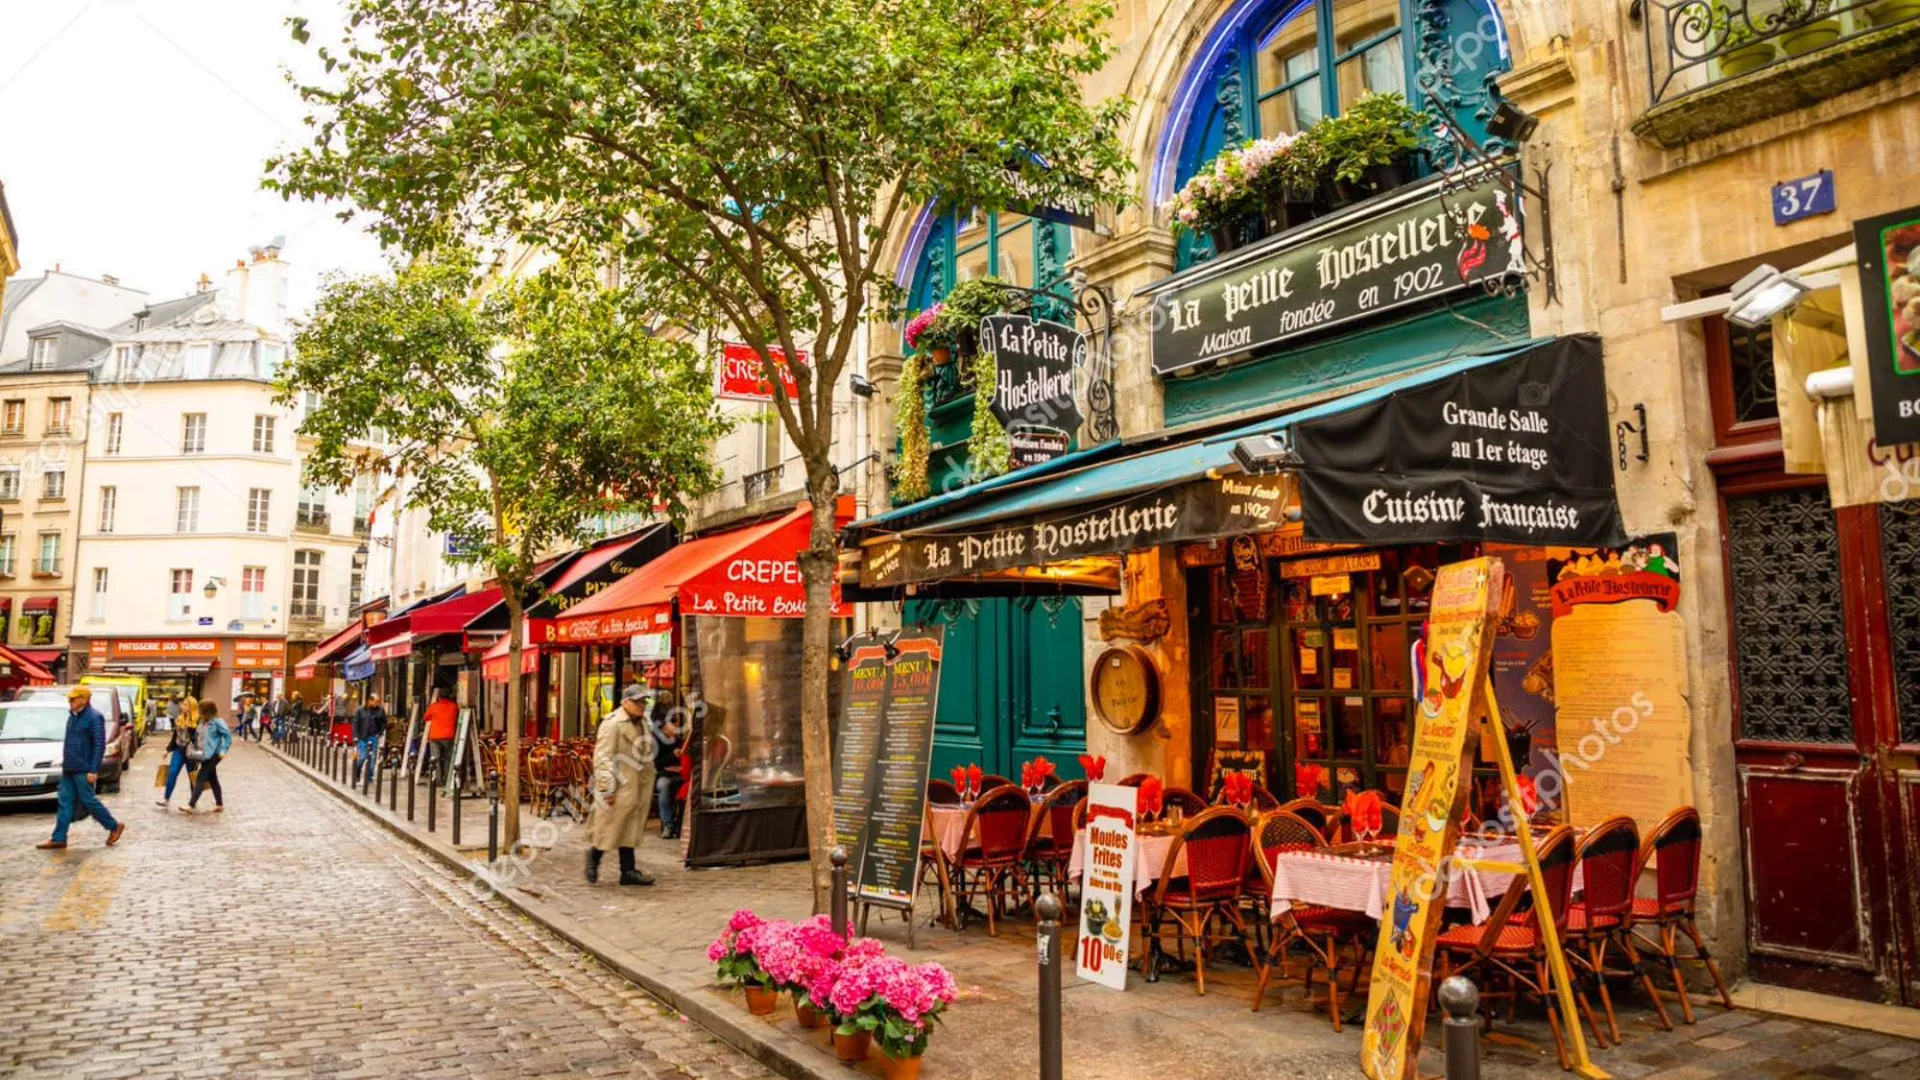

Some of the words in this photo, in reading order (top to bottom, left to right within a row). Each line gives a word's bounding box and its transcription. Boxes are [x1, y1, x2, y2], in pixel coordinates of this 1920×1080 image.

[1780, 178, 1823, 216] 37
[1168, 298, 1201, 334] La
[1199, 325, 1251, 357] Maison
[1279, 298, 1336, 334] fondée
[1358, 285, 1379, 310] en
[1393, 264, 1443, 299] 1902
[999, 323, 1020, 354] La
[1021, 324, 1068, 363] Petite
[999, 365, 1073, 412] Hostellerie
[1443, 401, 1506, 433] Grande
[1510, 410, 1549, 434] Salle
[1451, 439, 1472, 459] au
[1475, 438, 1503, 462] 1er
[1507, 441, 1549, 470] étage
[1244, 502, 1271, 519] 1902
[1362, 489, 1465, 525] Cuisine
[923, 543, 952, 570] La
[958, 530, 1026, 569] Petite
[1033, 499, 1179, 557] Hostellerie
[693, 594, 717, 611] La
[723, 592, 767, 612] Petite
[1090, 826, 1128, 850] Moules
[1093, 847, 1123, 869] Frites
